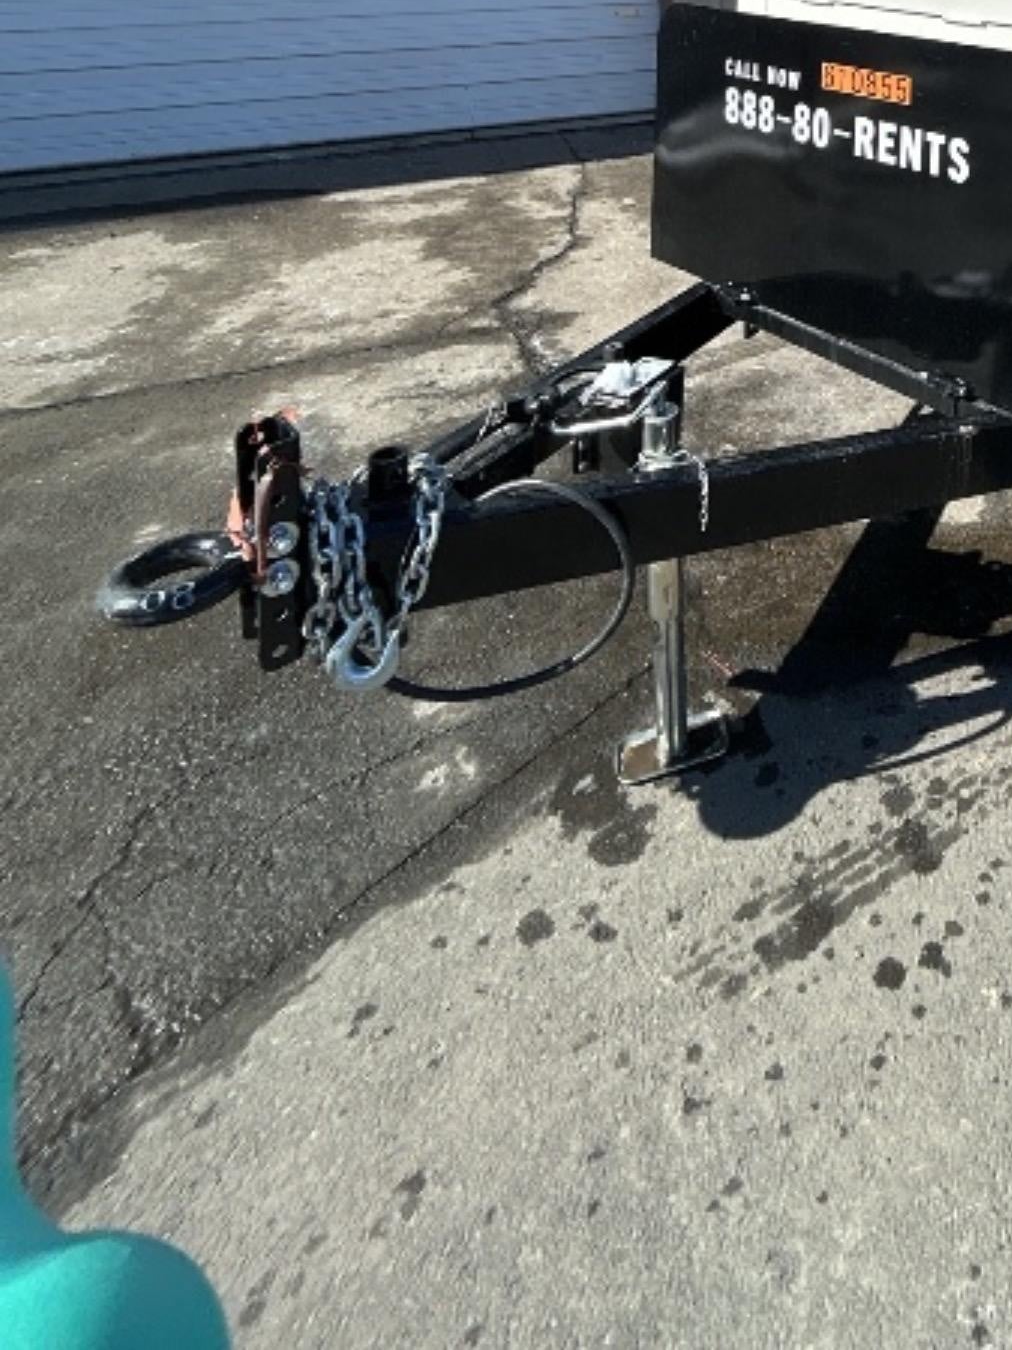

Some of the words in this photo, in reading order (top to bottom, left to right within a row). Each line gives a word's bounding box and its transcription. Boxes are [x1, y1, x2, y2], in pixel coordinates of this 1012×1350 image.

[725, 57, 761, 82] CALL
[767, 65, 801, 91] NOW
[724, 86, 970, 184] 888-80-RENTS
